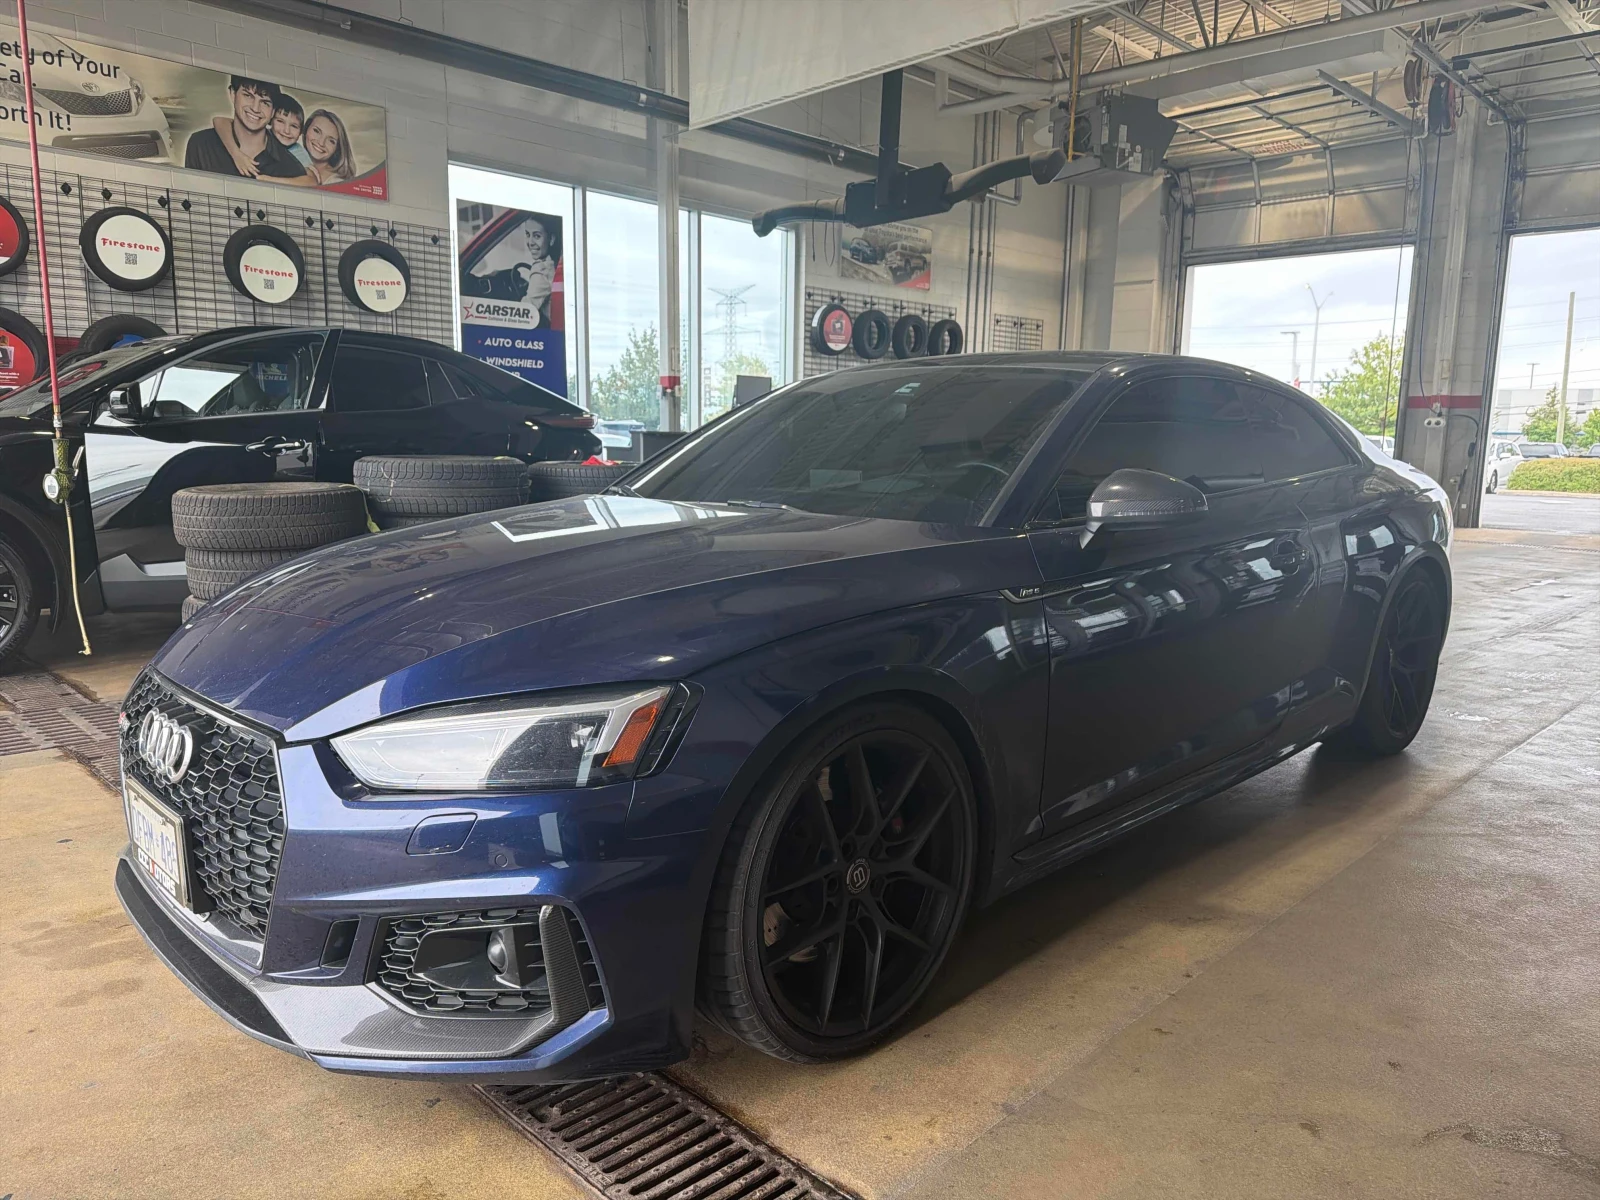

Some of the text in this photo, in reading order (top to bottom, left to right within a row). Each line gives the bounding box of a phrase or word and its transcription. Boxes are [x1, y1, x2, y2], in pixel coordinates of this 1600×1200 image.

[43, 49, 64, 67] of
[71, 52, 120, 78] Your
[49, 110, 71, 131] It!
[101, 237, 160, 252] Firestone
[244, 264, 294, 278] Firestone
[357, 278, 402, 287] Firestone
[475, 303, 531, 319] CARSTAR
[484, 337, 544, 350] AUTO GLASS
[486, 356, 544, 369] WINDSHIELD
